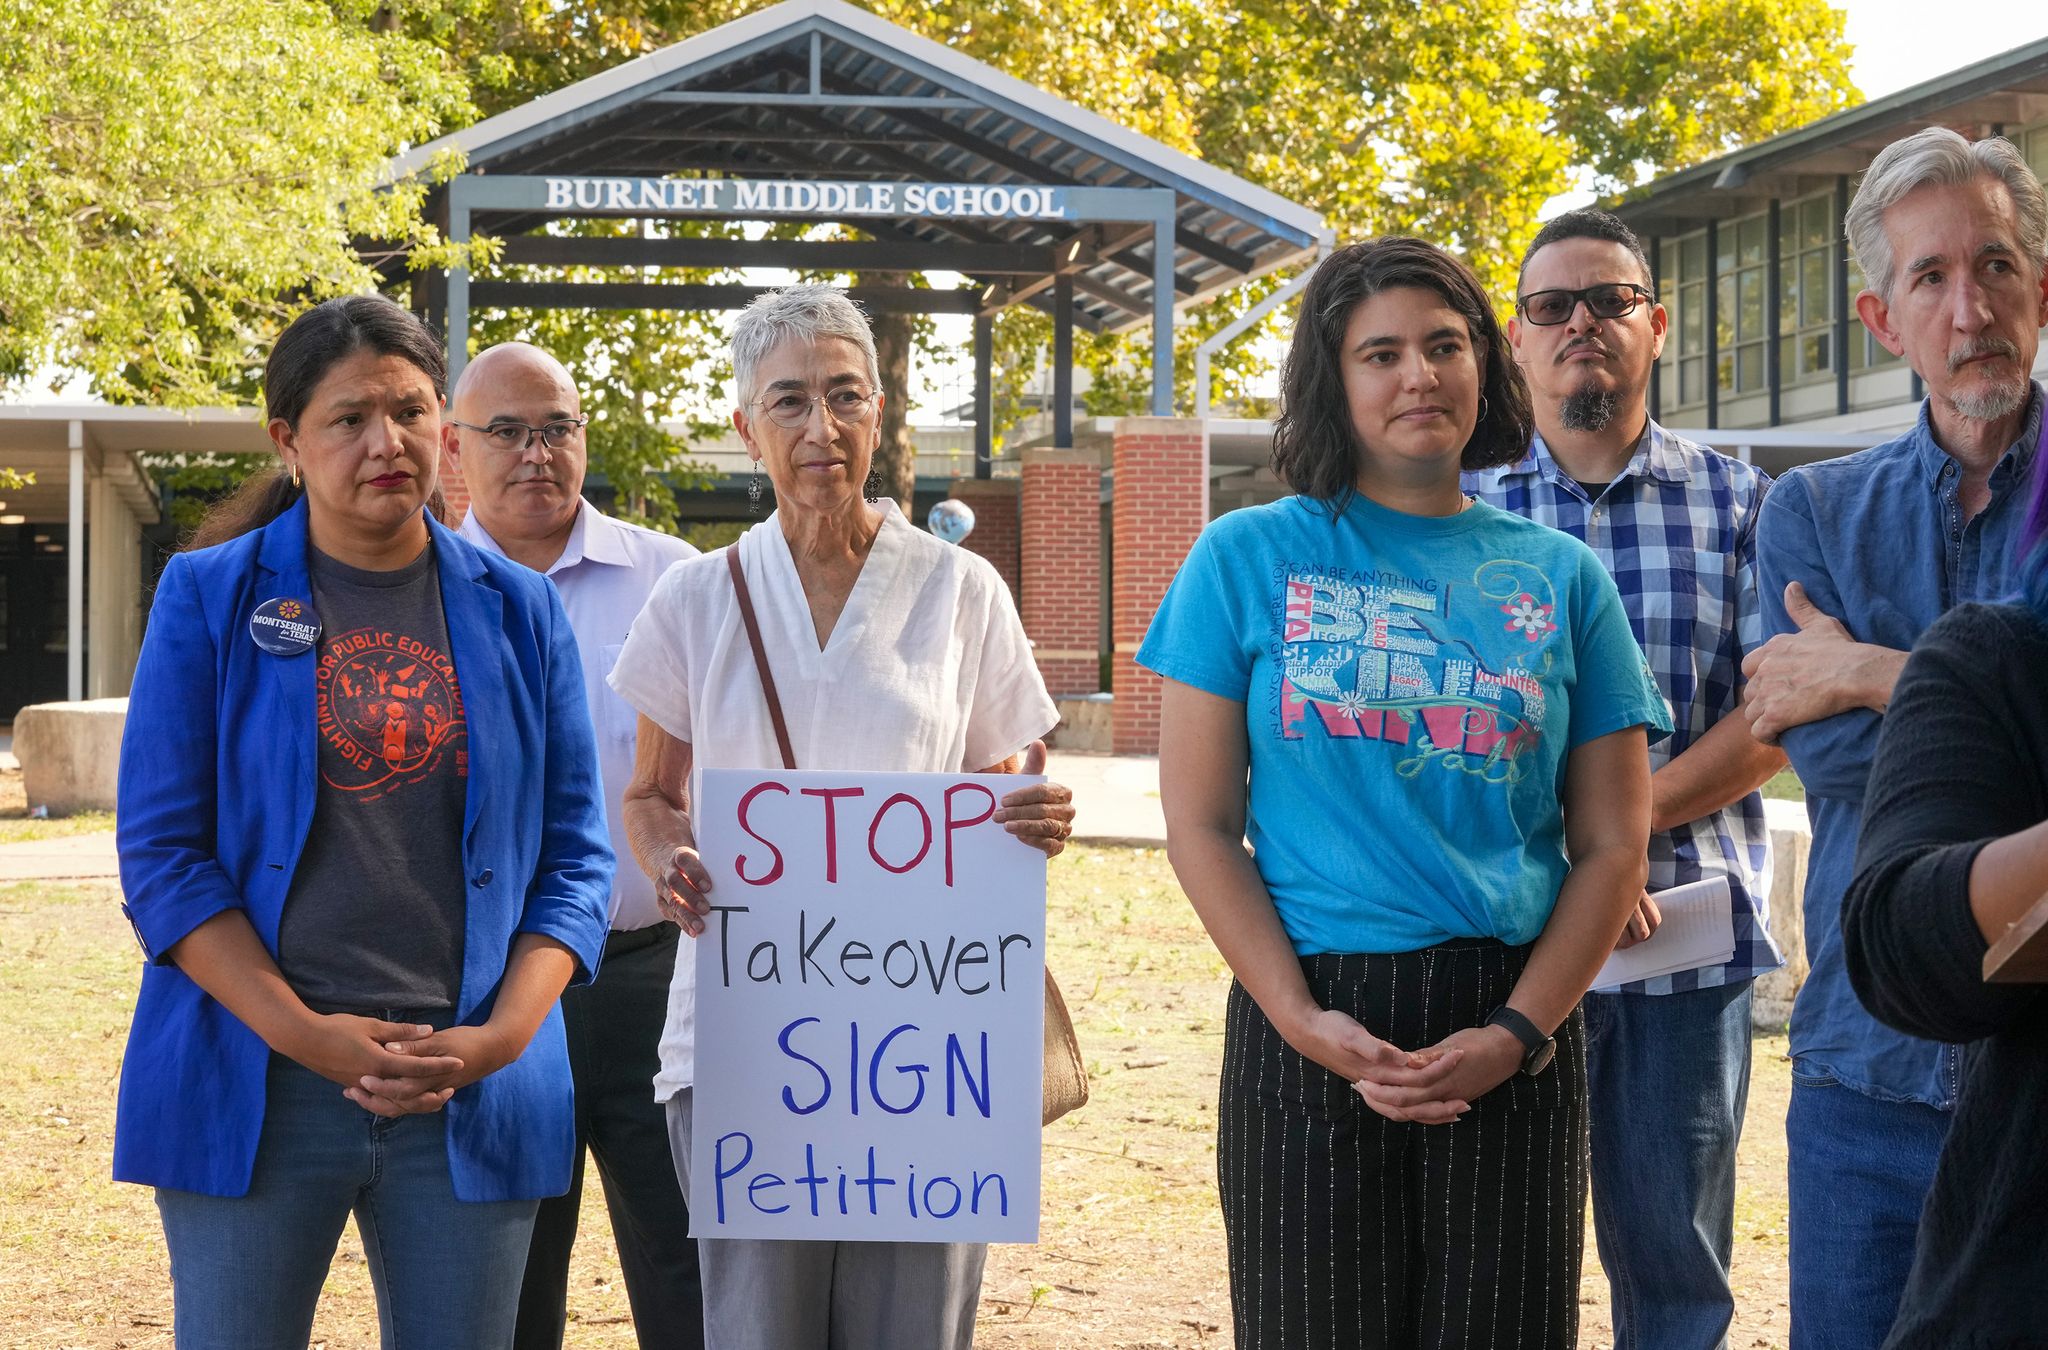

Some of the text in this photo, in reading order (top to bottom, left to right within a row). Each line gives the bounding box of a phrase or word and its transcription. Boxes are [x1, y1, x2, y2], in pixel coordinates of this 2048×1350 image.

[544, 178, 1065, 217] BURNET MIDDLE SCHOOL
[1273, 559, 1287, 590] YOU
[1289, 562, 1438, 592] CAN BE ANYTHING
[253, 614, 317, 635] MONTSERRAT
[1270, 592, 1284, 637] WHERE
[1284, 581, 1314, 641] PTA
[290, 630, 315, 642] TEXAS
[331, 632, 394, 660] PUBLIC
[1373, 617, 1388, 649] LEAD
[316, 654, 339, 690] FOR
[1390, 674, 1422, 687] LEGACY
[1476, 670, 1546, 698] VOLUNTEER
[1269, 707, 1279, 717] A
[317, 692, 373, 772] FIGHTING
[1270, 722, 1282, 740] IN
[735, 781, 996, 887] STOP
[778, 1017, 991, 1119] SIGN
[715, 1132, 1008, 1224] Petition
